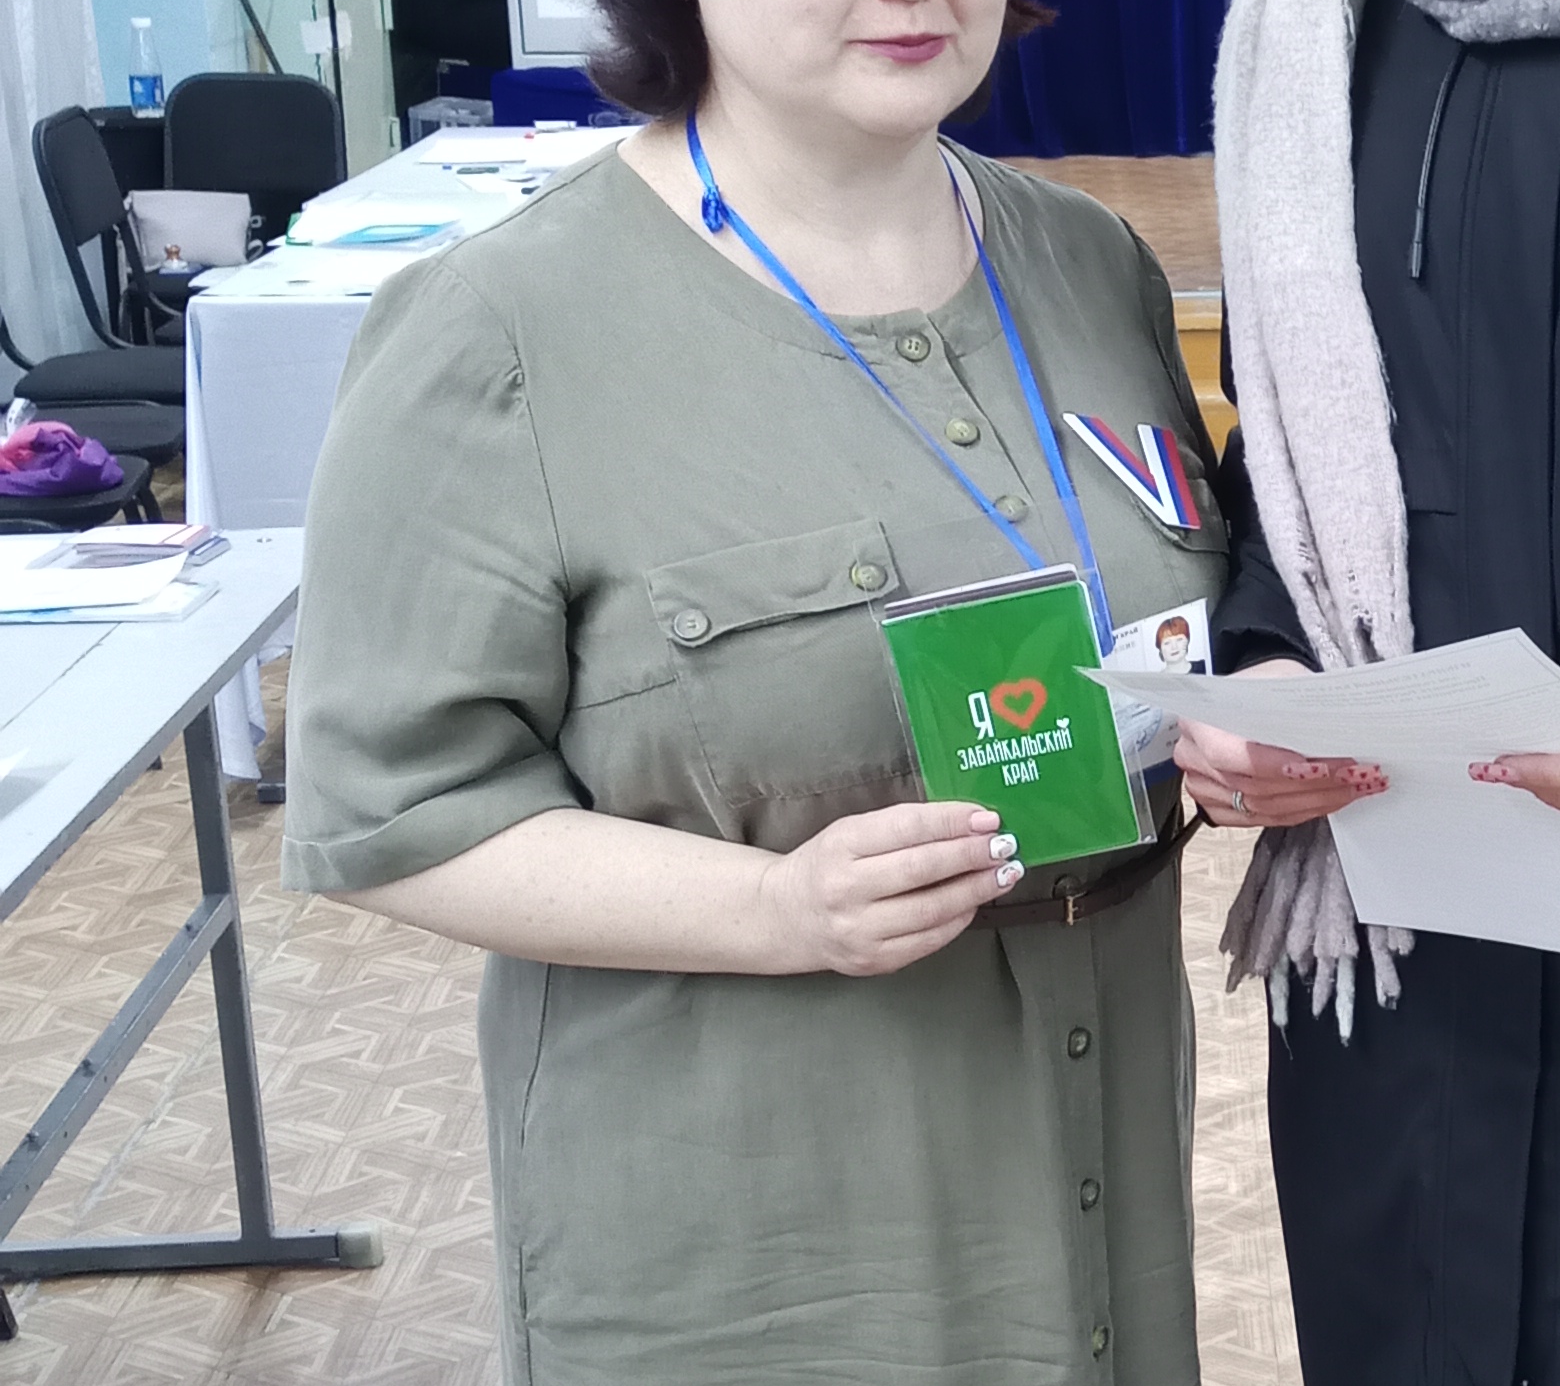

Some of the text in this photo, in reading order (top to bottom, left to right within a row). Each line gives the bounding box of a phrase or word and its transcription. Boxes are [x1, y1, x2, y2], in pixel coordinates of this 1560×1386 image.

[967, 691, 995, 741] Я
[956, 719, 1073, 771] ЗАБАЙКАЛЬСКИЙ
[1001, 757, 1040, 787] КРАЙ
